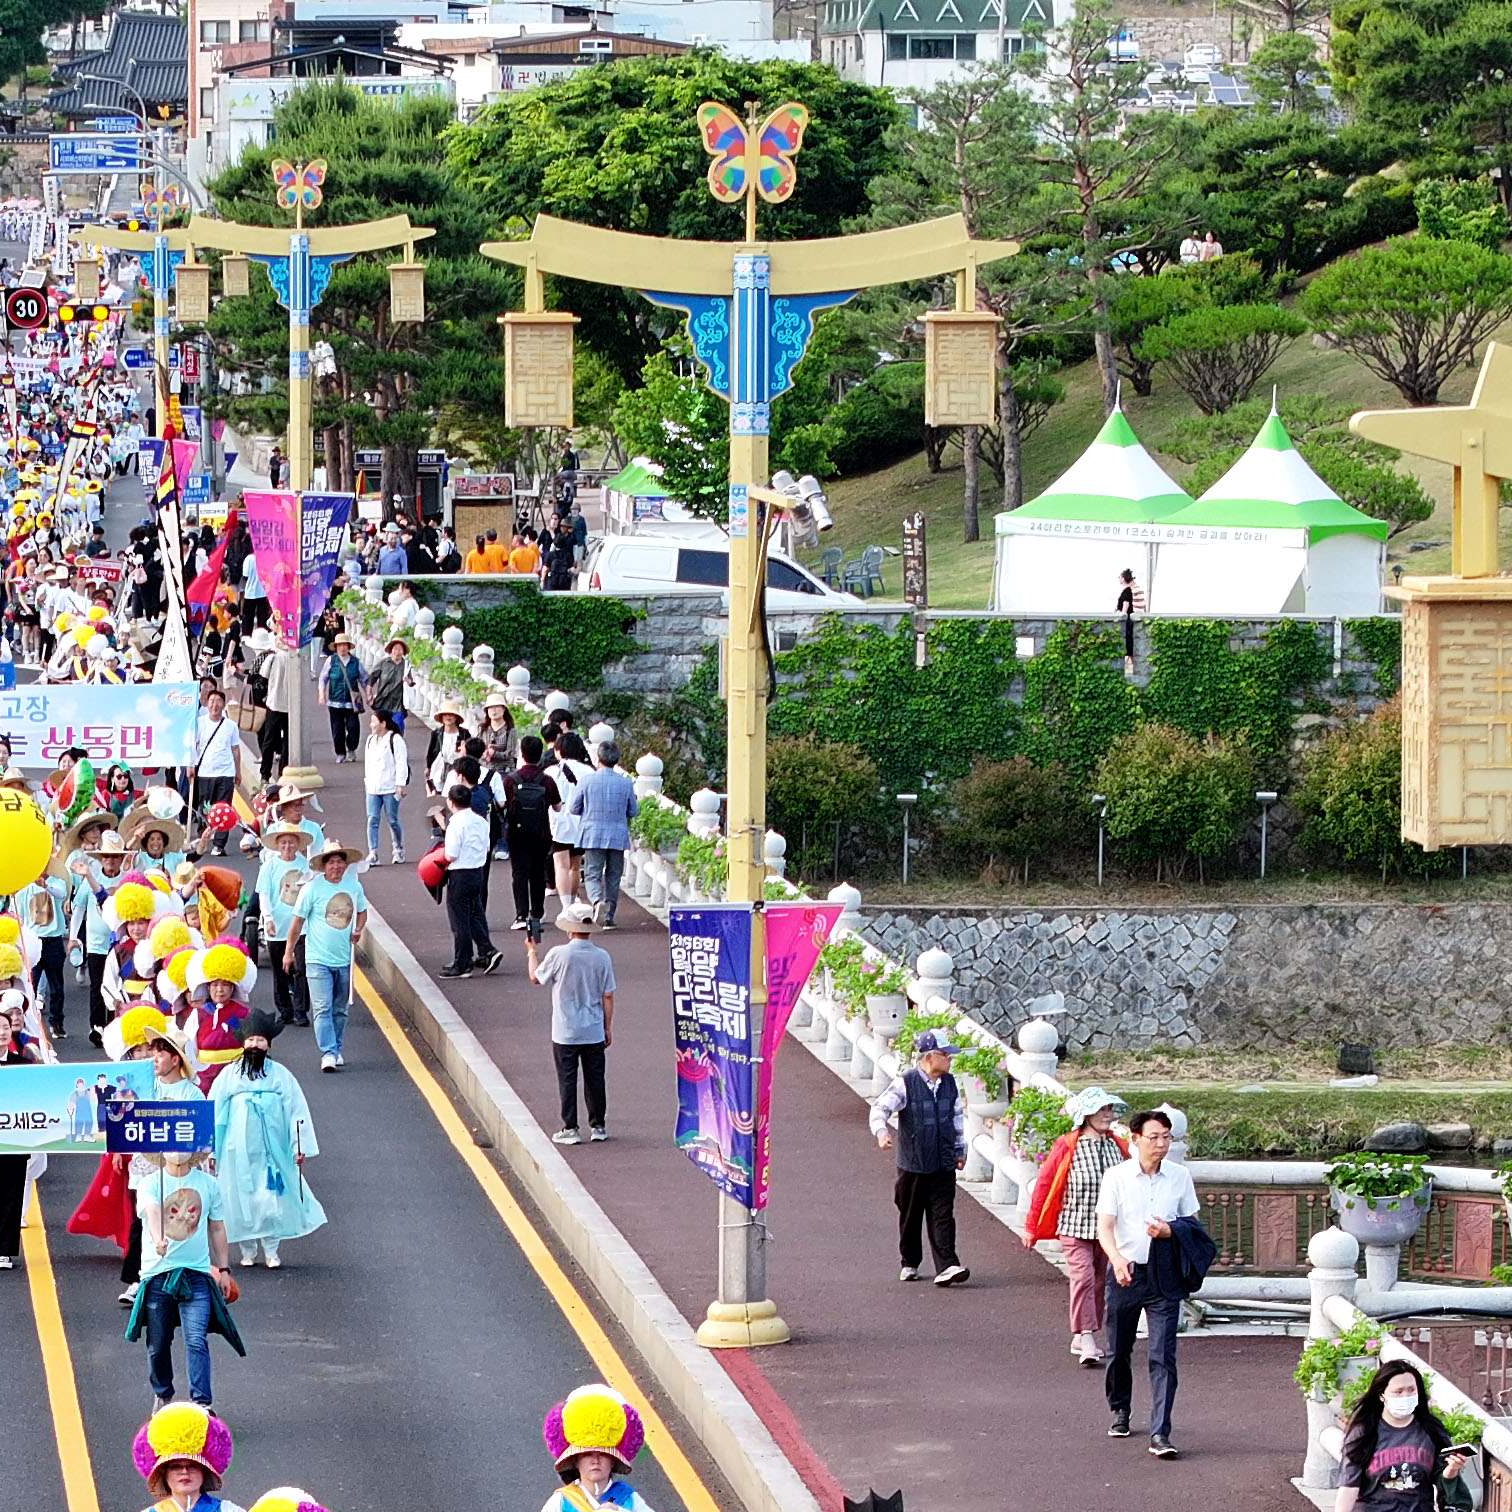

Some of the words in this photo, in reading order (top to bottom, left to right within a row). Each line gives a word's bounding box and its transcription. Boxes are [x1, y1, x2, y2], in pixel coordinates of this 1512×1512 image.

[16, 300, 38, 318] 30
[0, 695, 50, 722] 고장
[41, 725, 154, 760] 상동면
[124, 1120, 196, 1143] 하남읍
